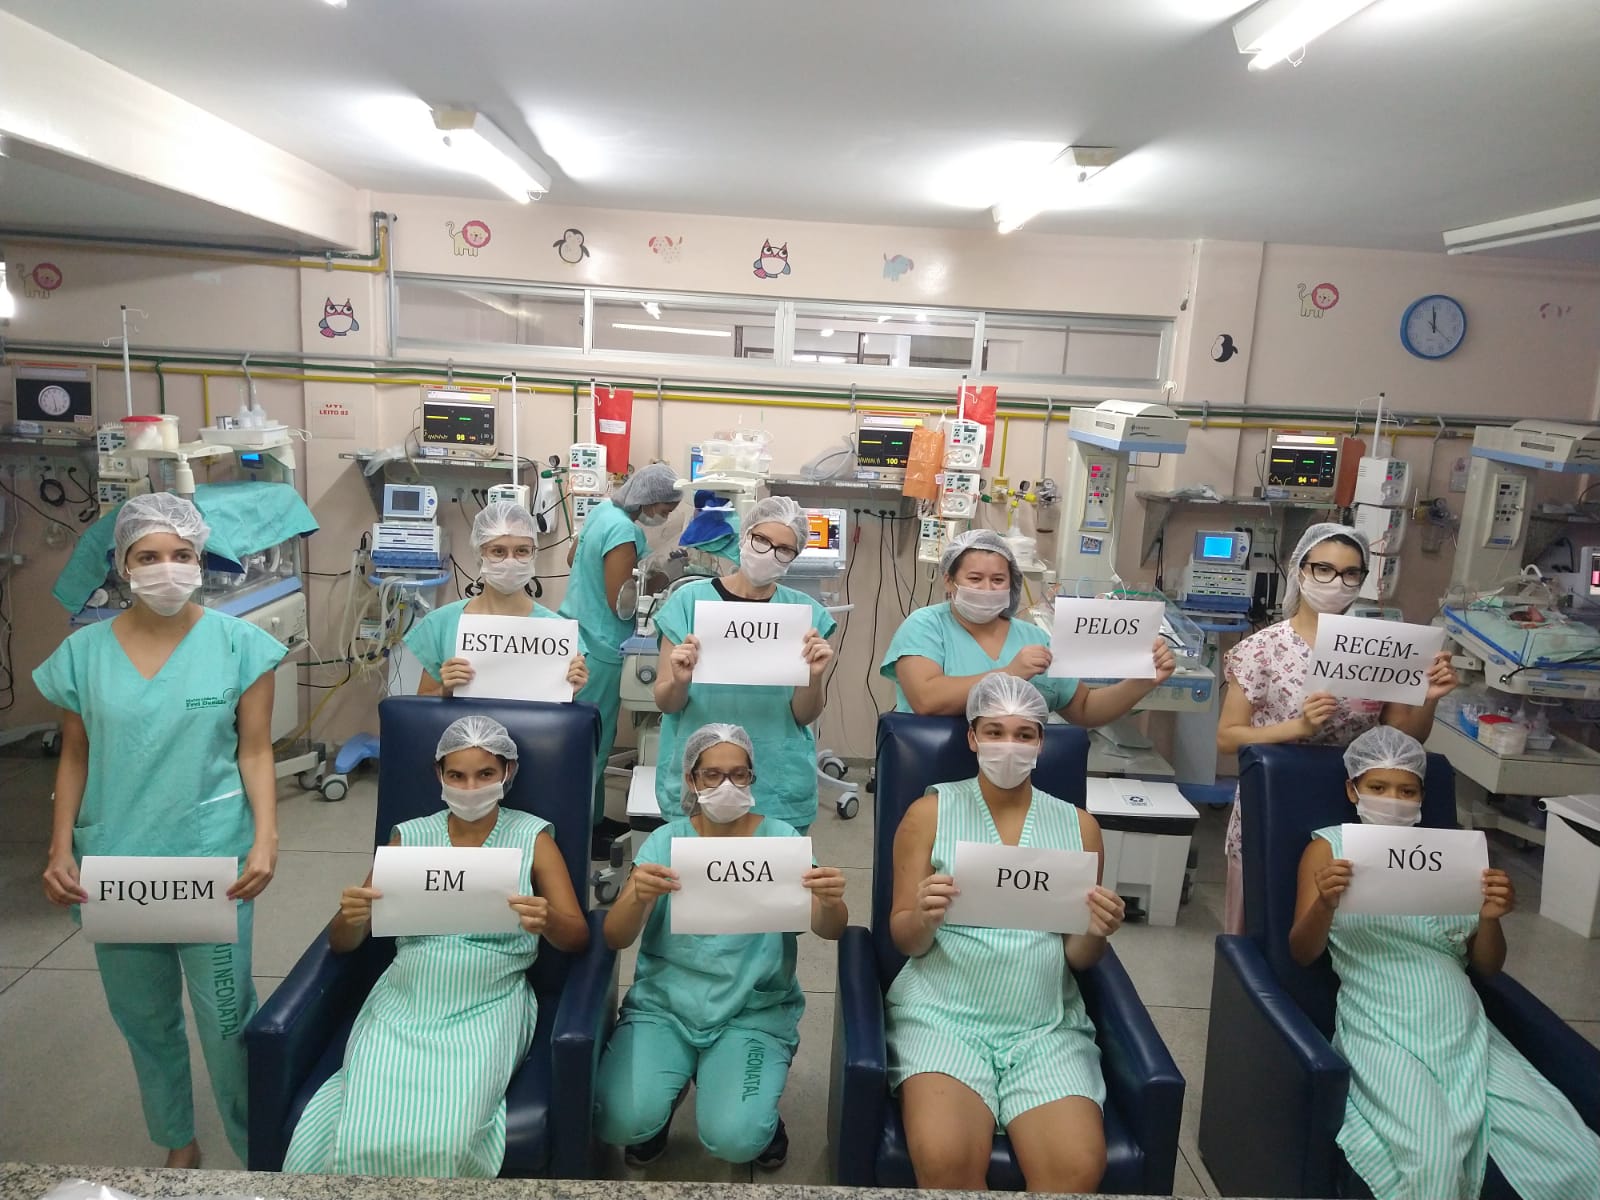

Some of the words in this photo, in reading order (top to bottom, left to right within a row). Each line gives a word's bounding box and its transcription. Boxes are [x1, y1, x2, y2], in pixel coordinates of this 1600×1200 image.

[886, 457, 899, 465] 100
[723, 620, 780, 644] AQUI
[1073, 616, 1140, 637] PELOS
[461, 632, 570, 657] ESTAMOS
[1333, 634, 1420, 660] RECÉM-
[1312, 660, 1424, 687] NASCIDOS
[1387, 844, 1443, 872] NÓS
[424, 869, 466, 892] EM
[706, 860, 775, 883] CASA
[995, 867, 1050, 892] POR
[99, 880, 215, 906] FIQUEM
[211, 943, 233, 966] UTI
[213, 967, 240, 1041] NEONATAL
[742, 1046, 766, 1102] NEONATAL
